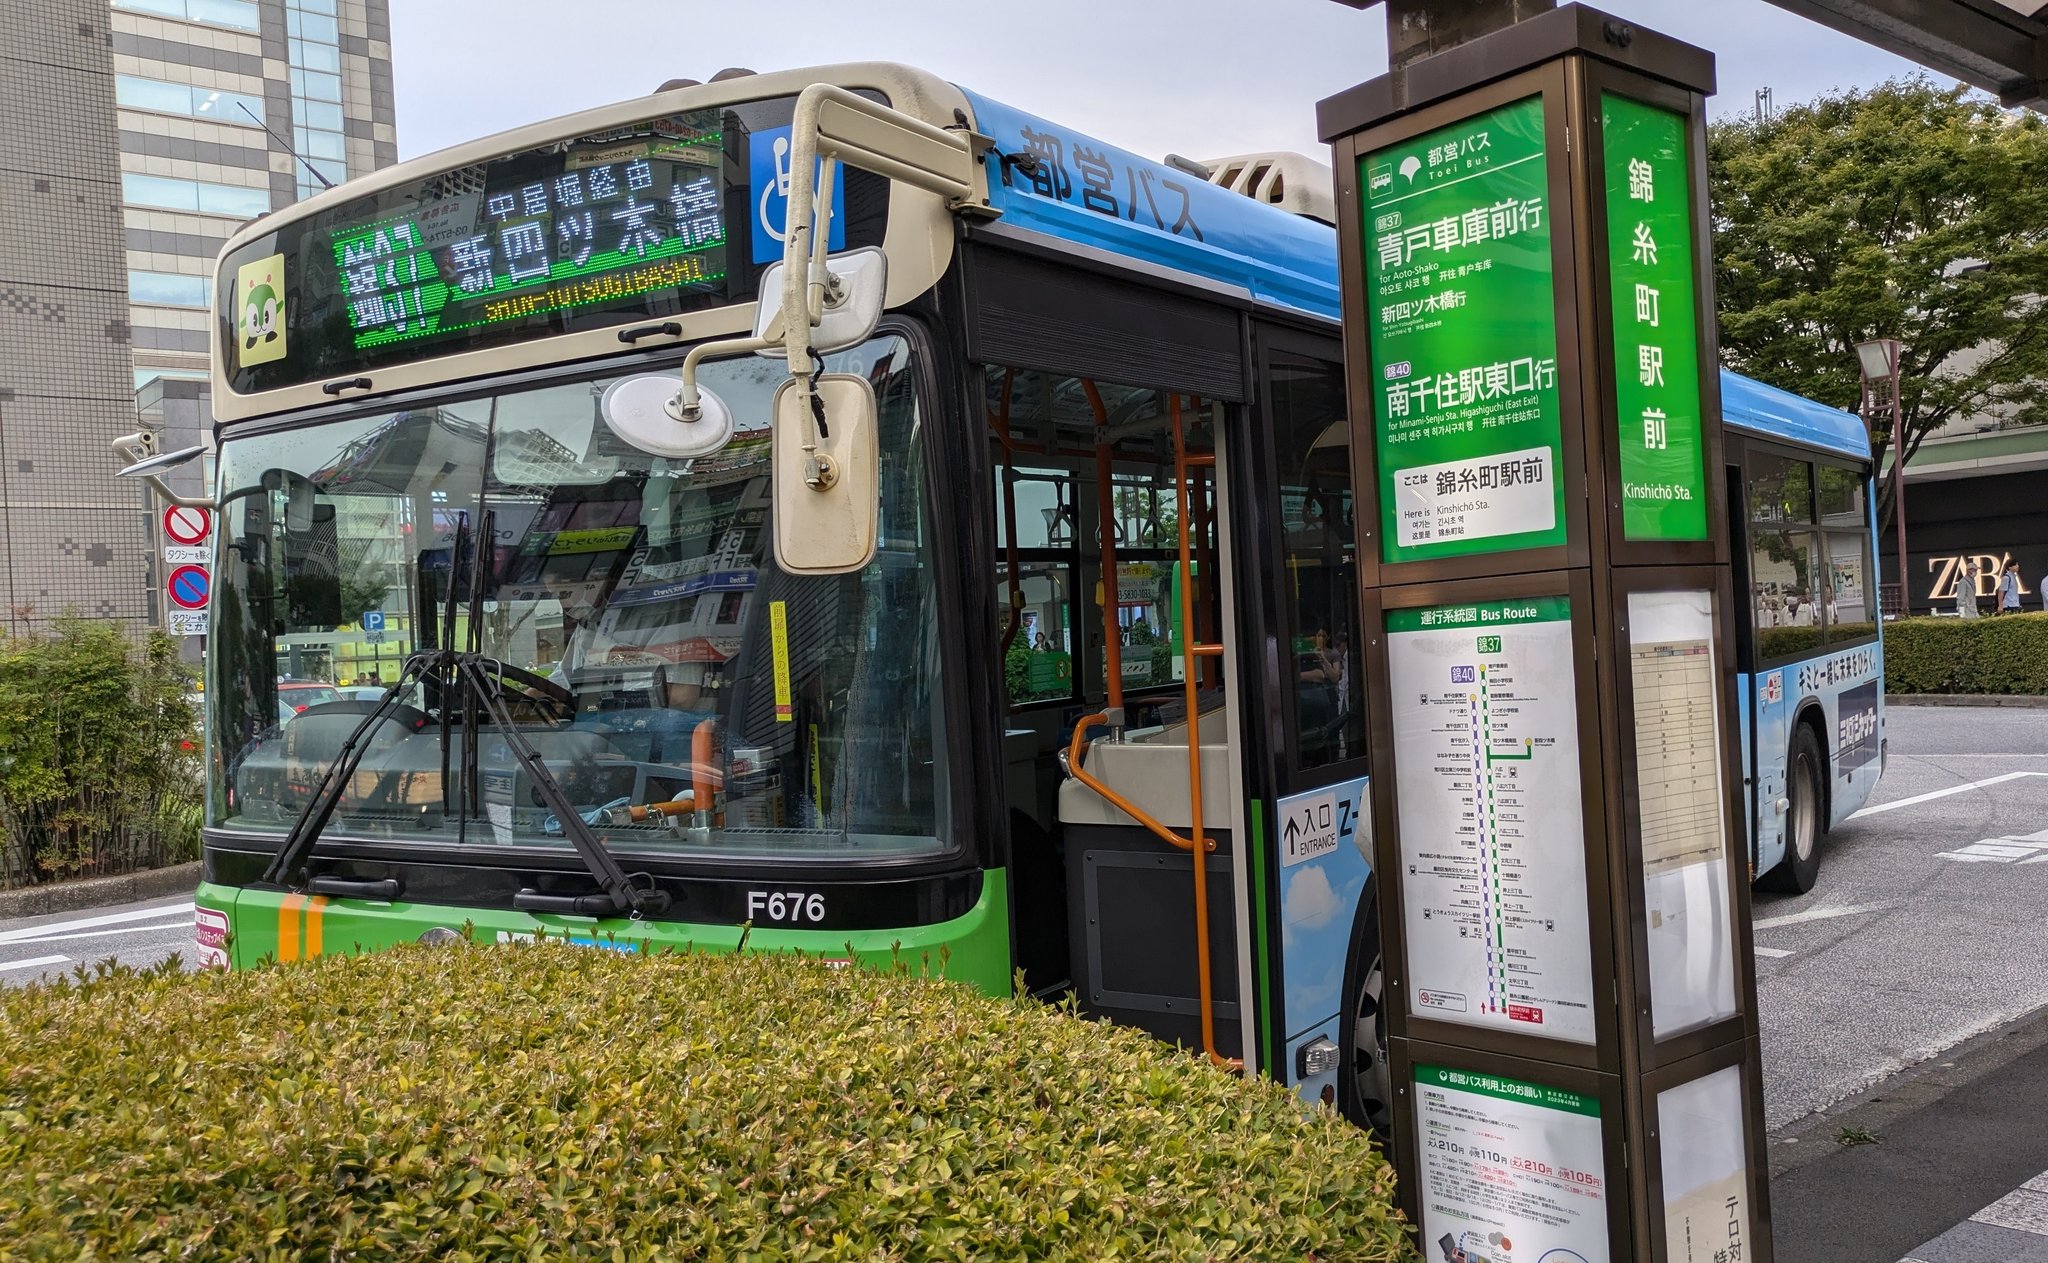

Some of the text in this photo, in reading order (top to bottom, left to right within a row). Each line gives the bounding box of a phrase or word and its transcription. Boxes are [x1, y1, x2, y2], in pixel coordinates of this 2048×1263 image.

[1427, 131, 1491, 168] 都営バス
[1429, 154, 1489, 180] Toei Bus
[1018, 125, 1204, 242] 都営バス
[1377, 214, 1400, 231] 錦37
[1377, 197, 1543, 271] 青戸車庫前行
[451, 177, 722, 293] 新四ツ木橋
[1380, 262, 1439, 284] for Aoto-Shako
[1439, 269, 1456, 282] 开往
[1379, 282, 1403, 296] 아오토
[1381, 290, 1467, 324] 新四ツ木橋行
[1628, 156, 1667, 451] 錦糸町駅前
[1386, 363, 1410, 379] 錦40
[1386, 357, 1555, 419] 南千住駅東口行
[1388, 394, 1539, 431] for Minami-Senju Sta. Higashiguchi (East Exit)
[1482, 417, 1497, 429] 开往
[1388, 432, 1408, 444] 미나미
[1404, 456, 1543, 497] ここは 錦糸町駅前
[1624, 481, 1693, 500] Kinshichō Sta.
[1404, 500, 1490, 519] Here is Kinshichō Sta.
[1412, 521, 1430, 530] 여기는
[168, 550, 210, 559] タクシーを除く
[174, 624, 208, 632] ここか
[369, 614, 381, 628] P
[1420, 607, 1537, 625] 運行系統図 Bus Route
[773, 603, 788, 698] 前扉からの降車
[1478, 637, 1500, 653] 錦37
[1452, 667, 1474, 682] 錦40
[1799, 648, 1876, 695] キミと一緒に未来をひらく。
[1303, 803, 1331, 836] 入口
[1339, 796, 1361, 838] Z-
[1300, 832, 1336, 856] ENTRANCE
[747, 892, 826, 924] F676
[1449, 1071, 1542, 1099] 都営バス利用上のお願い
